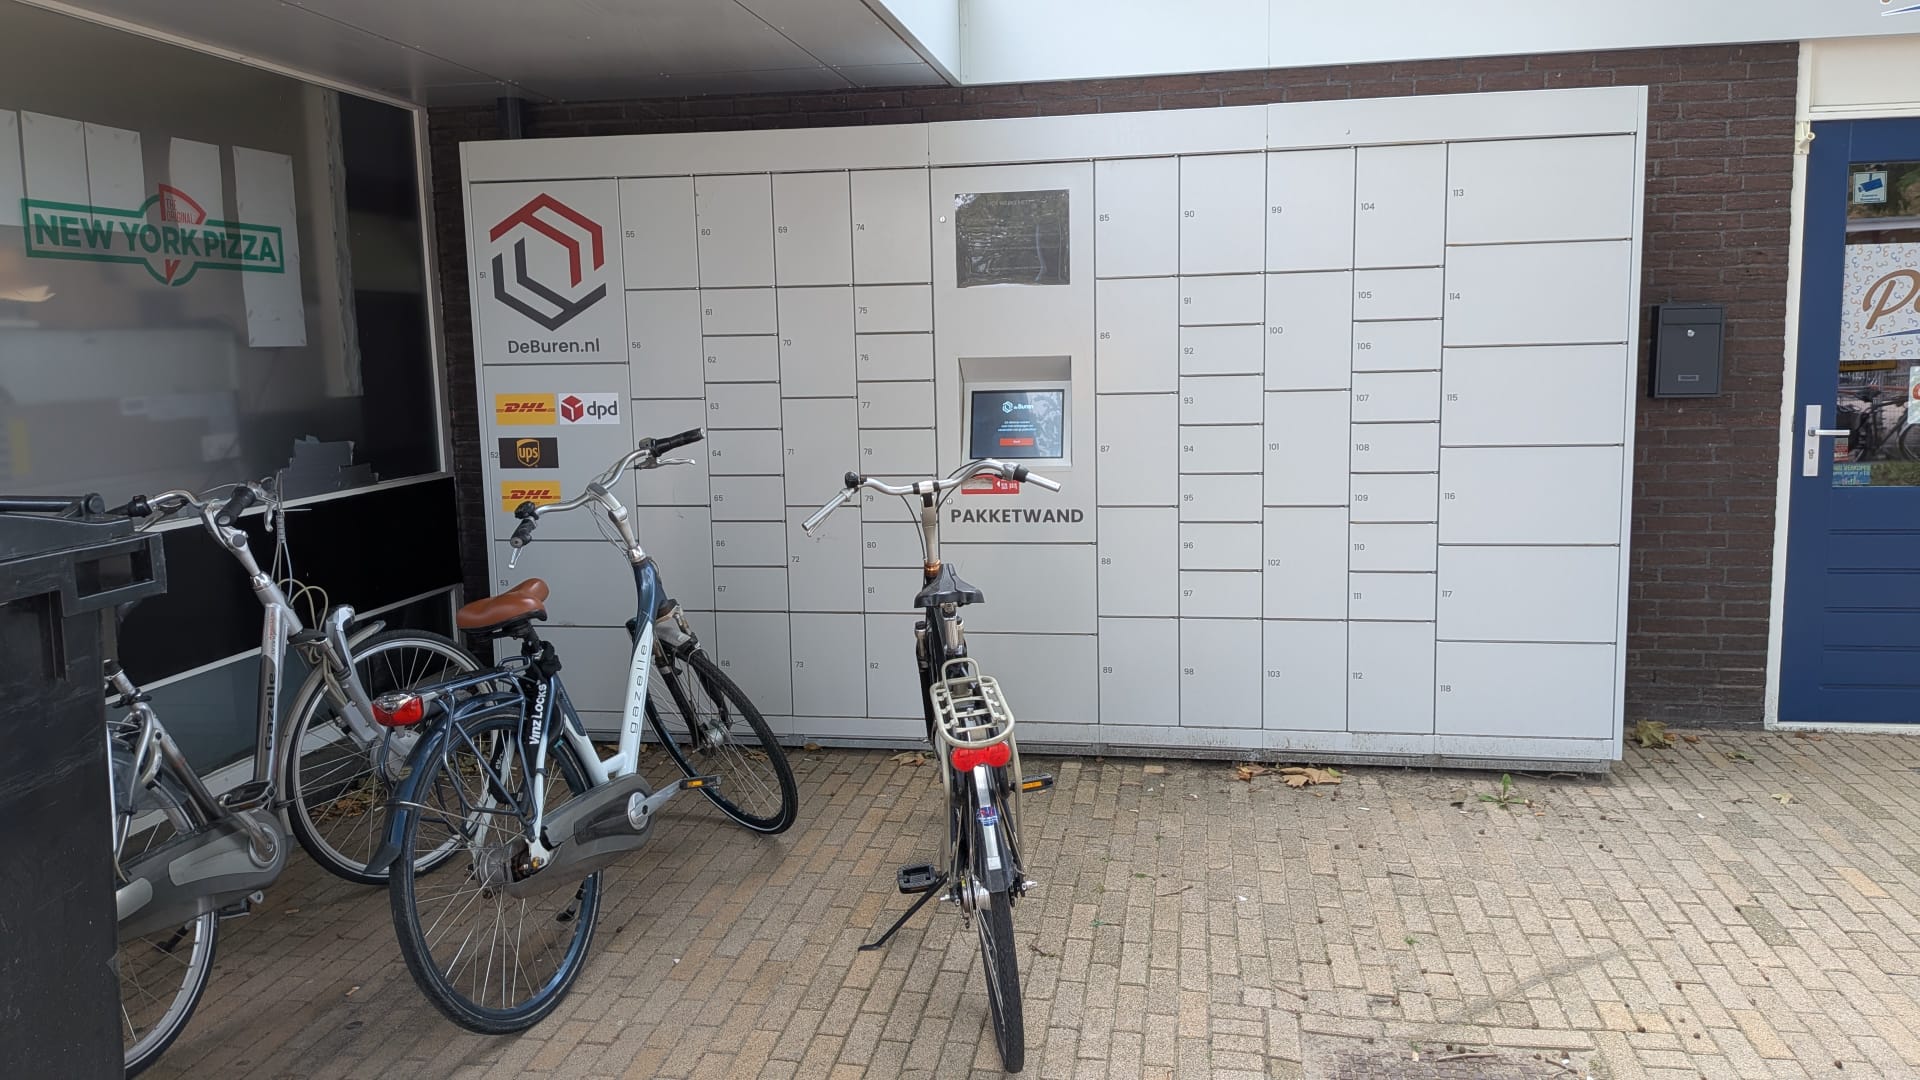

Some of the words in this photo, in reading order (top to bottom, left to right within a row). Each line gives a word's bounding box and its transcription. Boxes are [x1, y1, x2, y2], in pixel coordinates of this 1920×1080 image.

[1452, 188, 1465, 197] 113
[1271, 205, 1282, 214] 99
[1360, 202, 1375, 211] 104
[1098, 213, 1110, 222] 85
[1183, 209, 1194, 218] 90
[700, 227, 711, 236] 60
[777, 225, 788, 234] 69
[855, 223, 865, 232] 74
[33, 213, 114, 250] NEW
[120, 221, 202, 256] YORK
[203, 230, 277, 262] PIZZA
[625, 229, 636, 238] 55
[479, 271, 487, 279] 51
[1357, 290, 1372, 299] 105
[1449, 292, 1461, 301] 114
[1862, 268, 1920, 330] P
[1183, 296, 1192, 305] 91
[705, 307, 713, 316] 61
[857, 305, 868, 314] 75
[1269, 325, 1284, 334] 100
[1099, 331, 1110, 340] 86
[508, 338, 600, 354] DeBuren.nl
[631, 341, 642, 349] 56
[782, 338, 793, 347] 70
[1356, 341, 1371, 350] 106
[1183, 346, 1194, 355] 92
[707, 355, 717, 364] 62
[859, 353, 870, 362] 76
[1183, 396, 1194, 405] 93
[1355, 393, 1370, 402] 107
[1446, 393, 1459, 402] 115
[504, 402, 547, 413] DHL
[709, 401, 720, 410] 63
[860, 401, 871, 409] 77
[587, 400, 618, 420] dpd
[1099, 444, 1110, 453] 87
[1183, 444, 1194, 453] 94
[1268, 442, 1280, 451] 101
[1355, 443, 1370, 452] 108
[489, 451, 499, 459] 52
[518, 447, 538, 463] ups
[711, 449, 722, 457] 64
[786, 447, 795, 456] 71
[863, 447, 873, 456] 78
[510, 489, 553, 500] DHL
[713, 493, 724, 502] 65
[864, 494, 875, 503] 79
[1183, 493, 1194, 502] 95
[1353, 493, 1368, 502] 109
[1443, 491, 1456, 500] 116
[950, 508, 1084, 524] PAKKETWAND
[715, 539, 726, 548] 66
[866, 541, 877, 549] 80
[1183, 541, 1194, 550] 96
[1353, 543, 1366, 552] 110
[791, 555, 801, 563] 72
[1100, 557, 1111, 566] 88
[1267, 558, 1281, 567] 102
[499, 579, 510, 587] 53
[717, 585, 727, 593] 67
[867, 585, 876, 594] 81
[1183, 589, 1194, 597] 97
[1441, 589, 1453, 598] 117
[1353, 591, 1363, 600] 111
[720, 659, 731, 668] 68
[794, 660, 805, 669] 73
[869, 661, 880, 670] 82
[1102, 665, 1113, 674] 89
[1183, 667, 1194, 676] 98
[1266, 669, 1281, 678] 103
[1351, 671, 1364, 680] 112
[1439, 684, 1452, 693] 118
